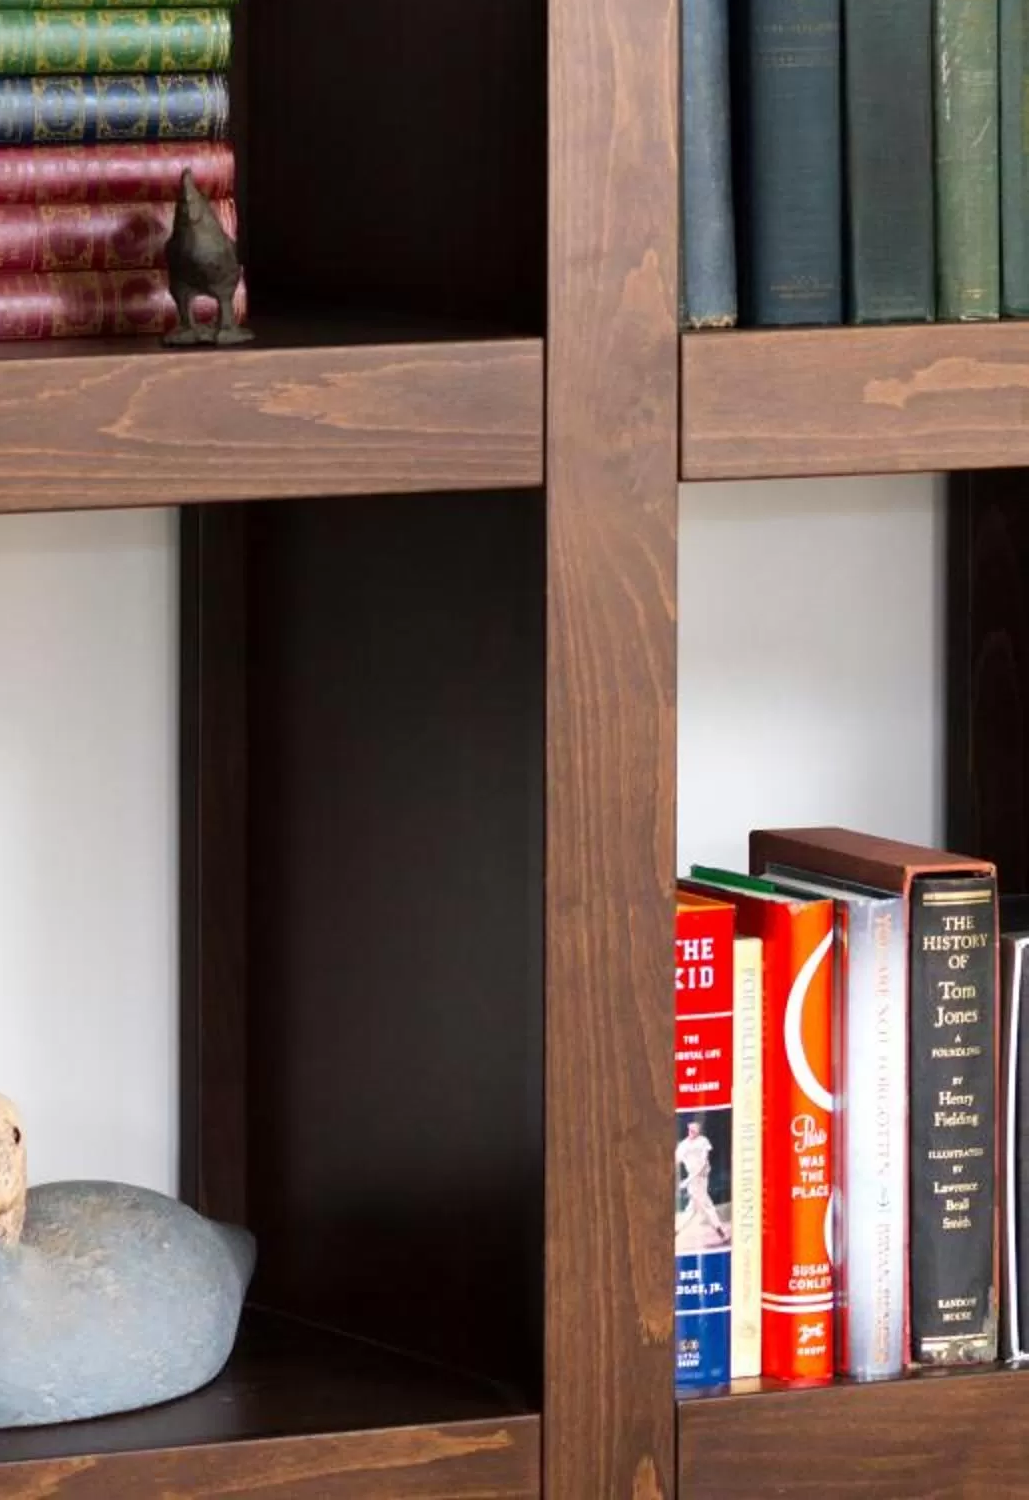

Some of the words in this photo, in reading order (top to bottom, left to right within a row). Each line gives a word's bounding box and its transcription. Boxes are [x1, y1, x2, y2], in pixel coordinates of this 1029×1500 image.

[942, 916, 975, 931] THE
[923, 934, 987, 950] HISTORY
[948, 954, 970, 969] OF
[938, 981, 976, 1000] Tom
[933, 1006, 978, 1028] Jones
[938, 1091, 974, 1107] Henry
[933, 1112, 979, 1127] Fielding
[928, 1148, 984, 1159] ILLUSTRATED
[799, 1155, 825, 1168] WAS
[800, 1169, 824, 1182] THE
[791, 1183, 829, 1199] PLACE
